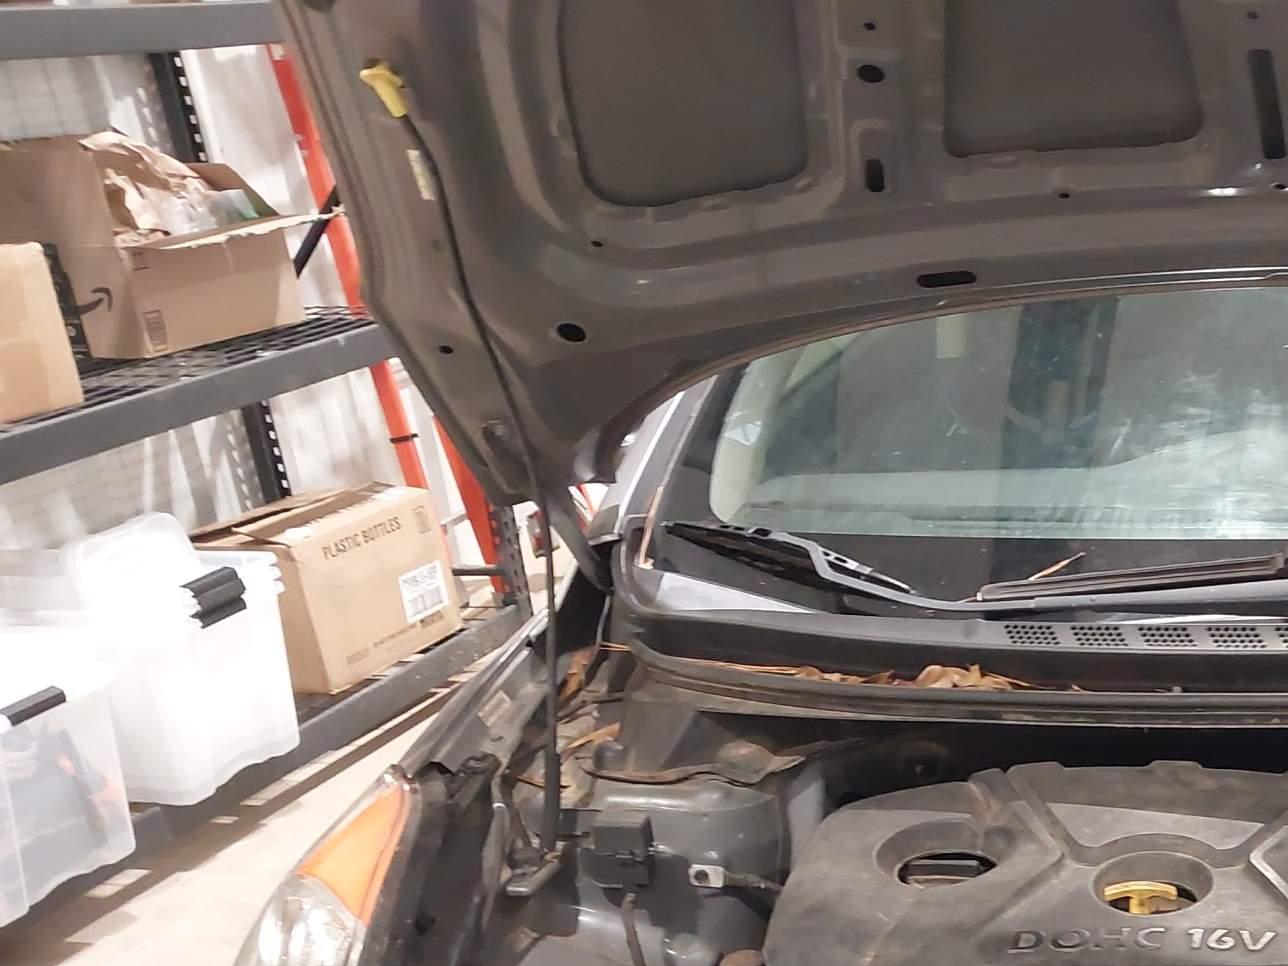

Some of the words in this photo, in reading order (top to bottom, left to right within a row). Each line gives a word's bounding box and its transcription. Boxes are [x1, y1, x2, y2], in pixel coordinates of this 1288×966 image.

[321, 532, 362, 560] PLASTIC
[361, 516, 401, 544] BOTTLES
[1007, 927, 1168, 954] DOHC
[1187, 928, 1278, 951] 16V
